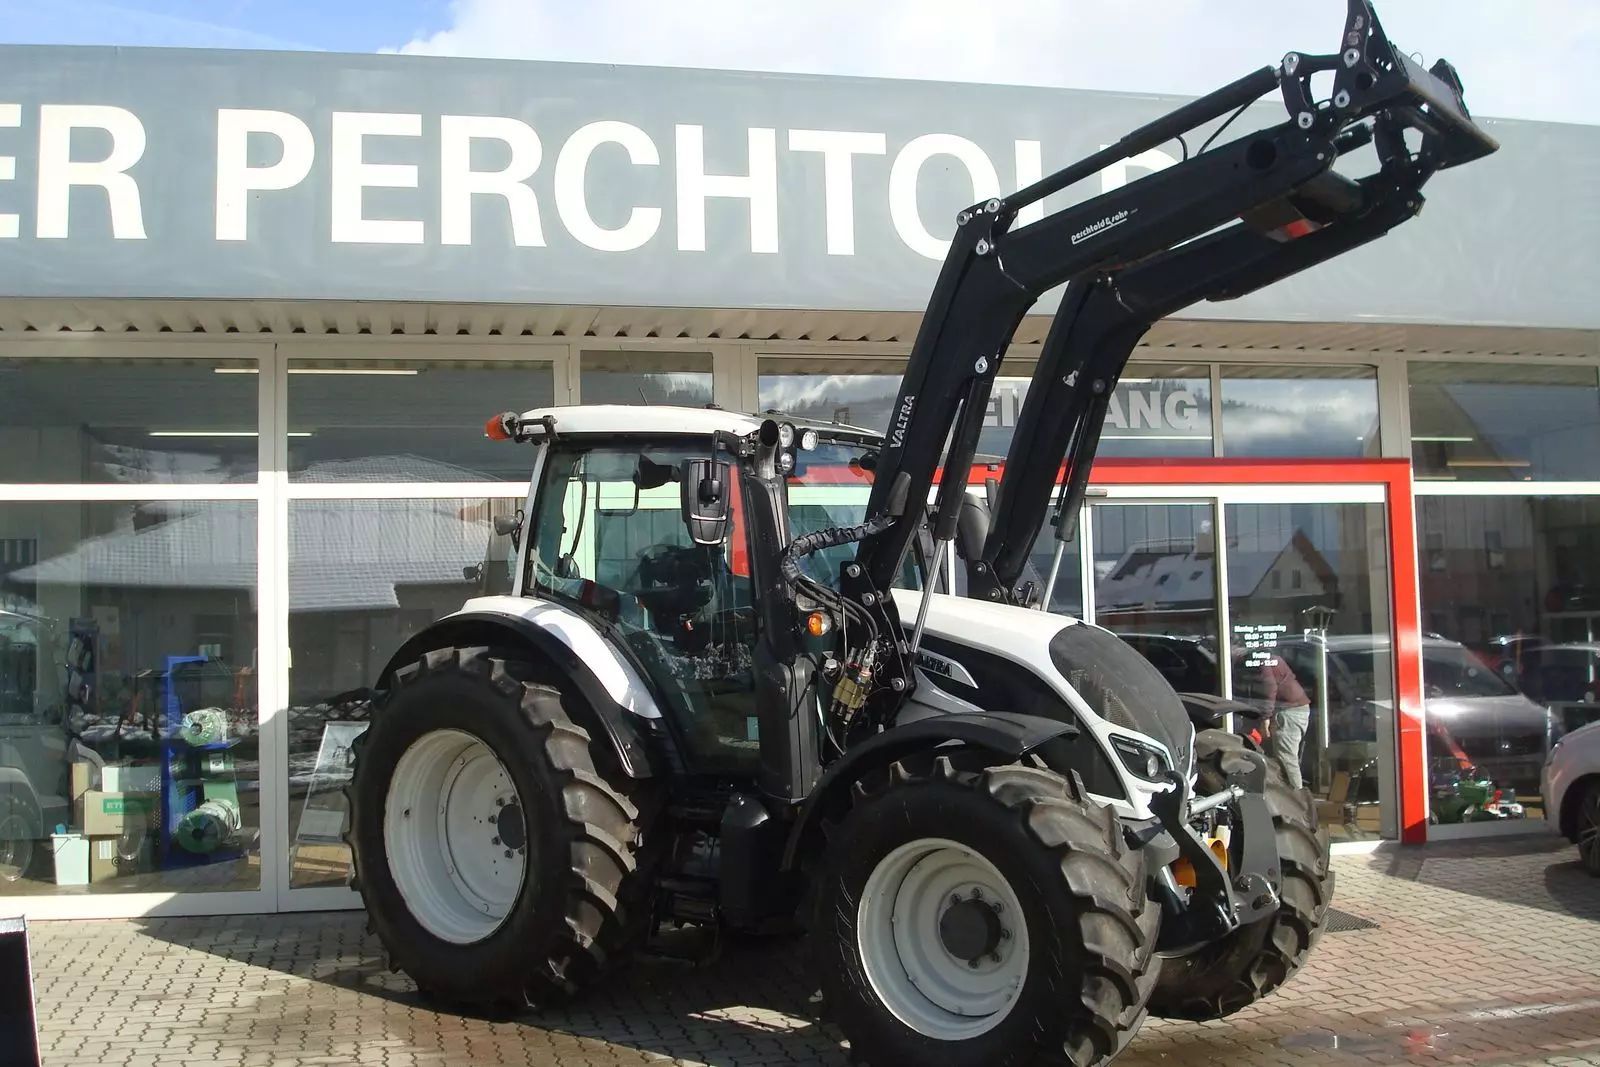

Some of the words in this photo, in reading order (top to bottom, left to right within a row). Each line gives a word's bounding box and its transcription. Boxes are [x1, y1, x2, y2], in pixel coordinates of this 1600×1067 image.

[0, 104, 148, 239] R
[889, 395, 915, 448] VALTRA
[983, 387, 1199, 430] EIANG
